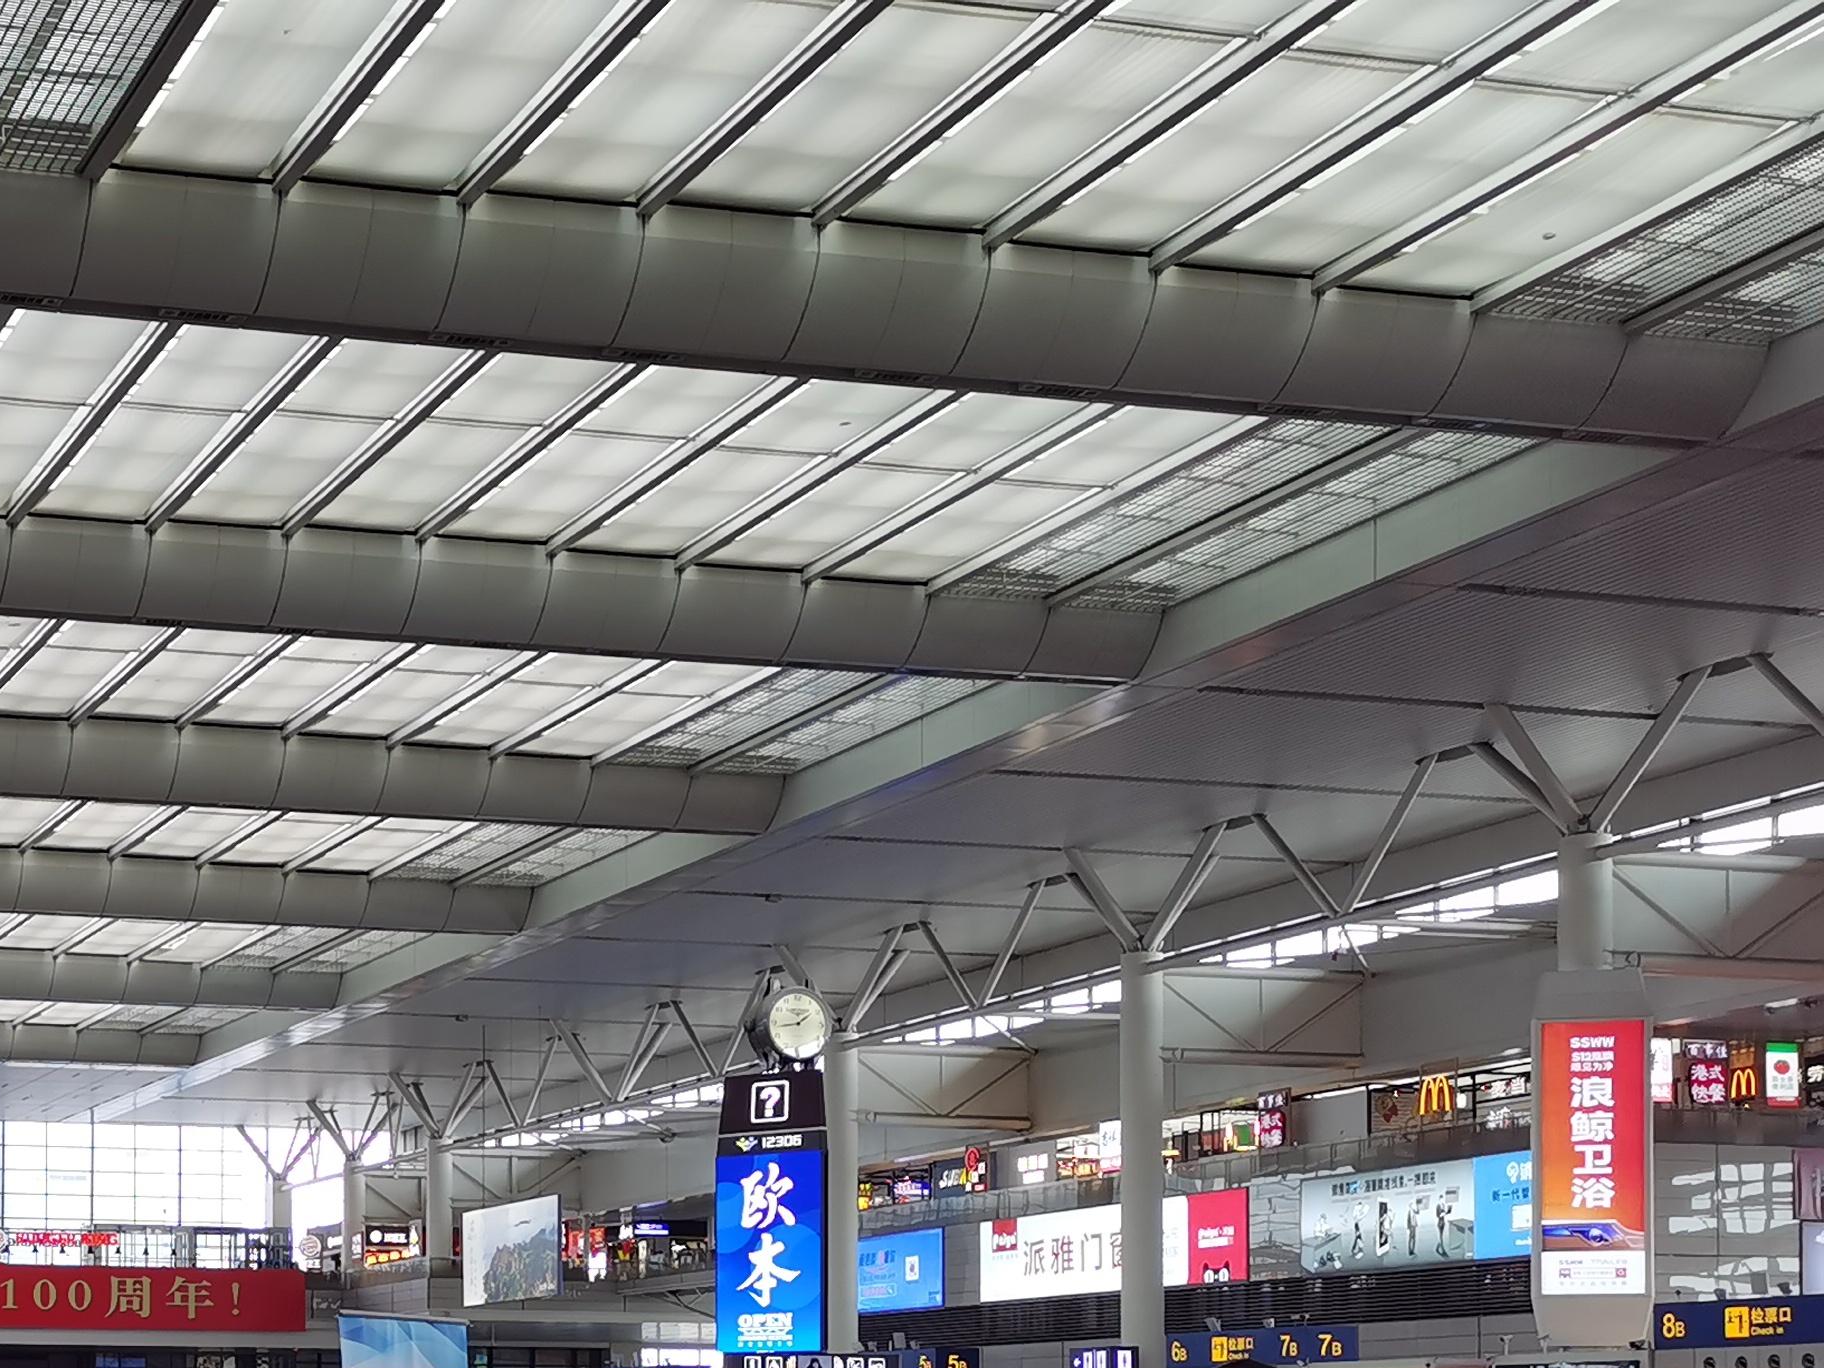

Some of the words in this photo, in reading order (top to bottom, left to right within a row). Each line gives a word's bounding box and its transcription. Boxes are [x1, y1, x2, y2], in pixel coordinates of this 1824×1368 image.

[1569, 1035, 1615, 1049] SSWW
[760, 1134, 802, 1149] 12306
[1568, 1076, 1616, 1209] 浪鲸卫浴
[735, 1162, 802, 1308] 欧本
[736, 1312, 794, 1328] OPEN
[1661, 1312, 1686, 1339] 8B
[1750, 1306, 1793, 1324] 检票口
[1170, 1341, 1189, 1362] 6B
[1279, 1334, 1299, 1357] 7B
[1317, 1333, 1343, 1357] 7B
